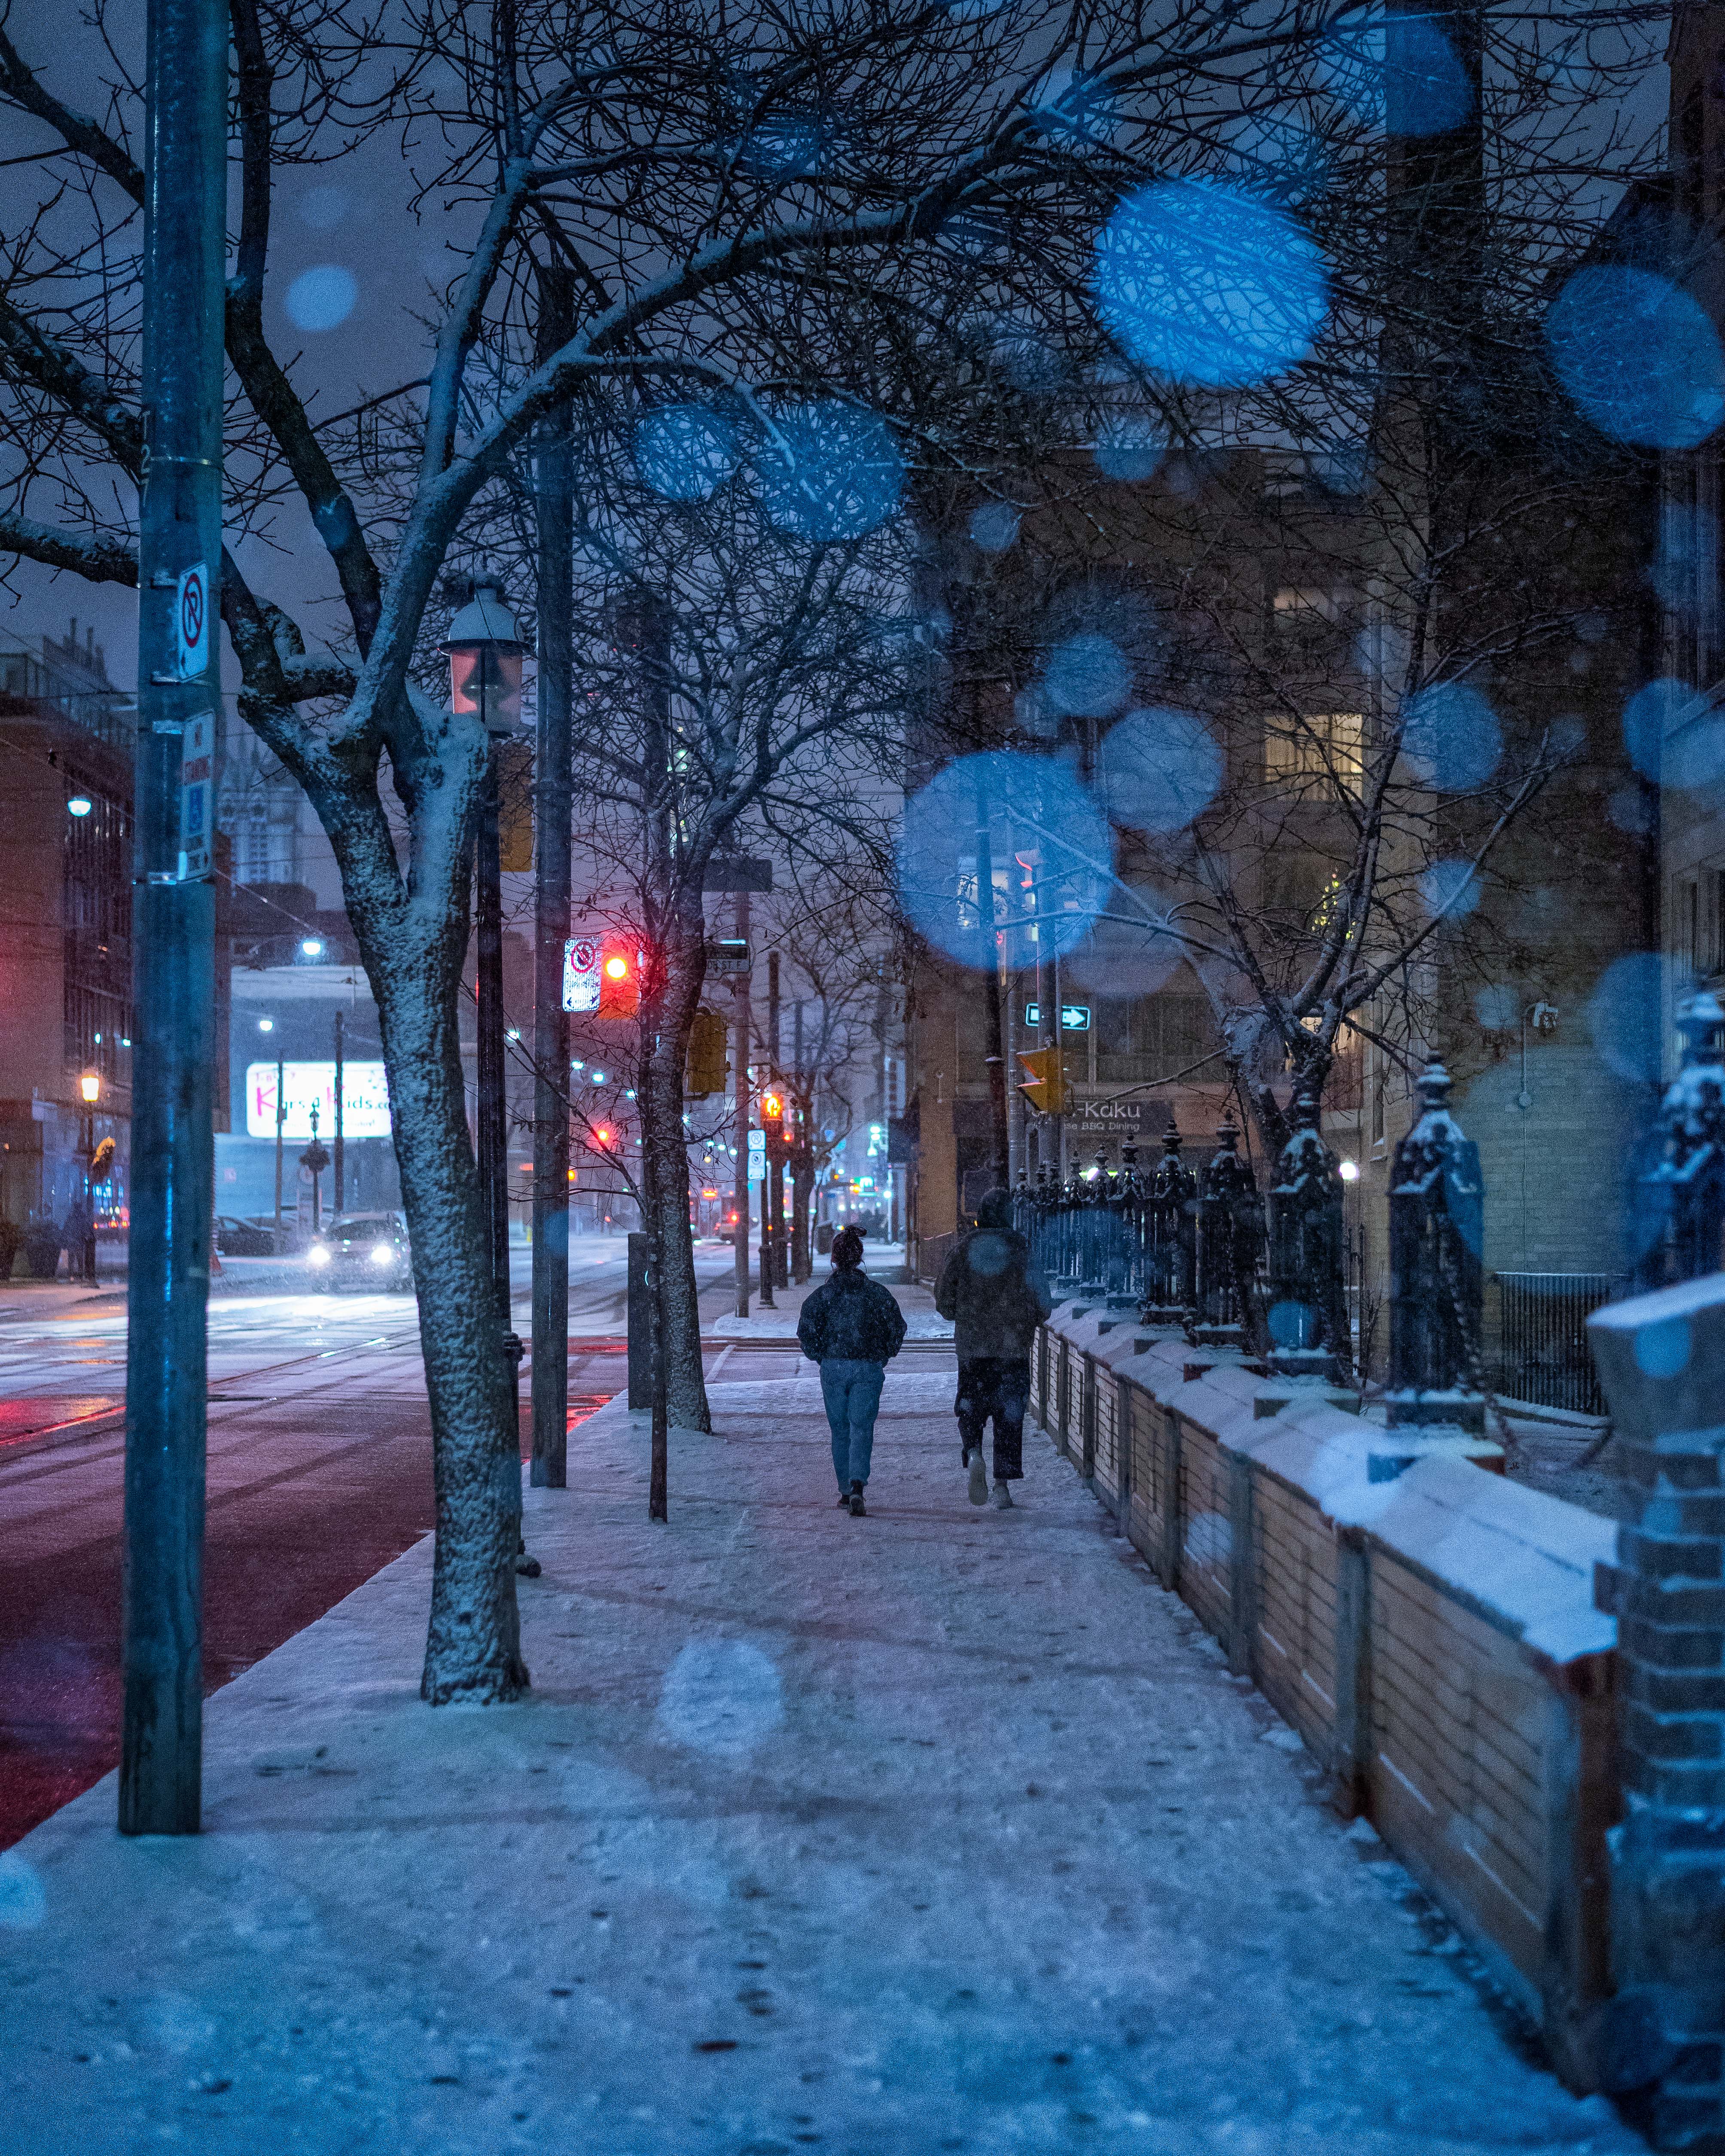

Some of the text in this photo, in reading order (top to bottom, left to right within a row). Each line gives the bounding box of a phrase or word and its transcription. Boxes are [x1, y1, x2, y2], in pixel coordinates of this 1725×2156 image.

[722, 960, 733, 970] ST
[1072, 1102, 1140, 1118] -Kaku
[1081, 1122, 1105, 1130] BBQ
[1109, 1122, 1140, 1132] Dining
